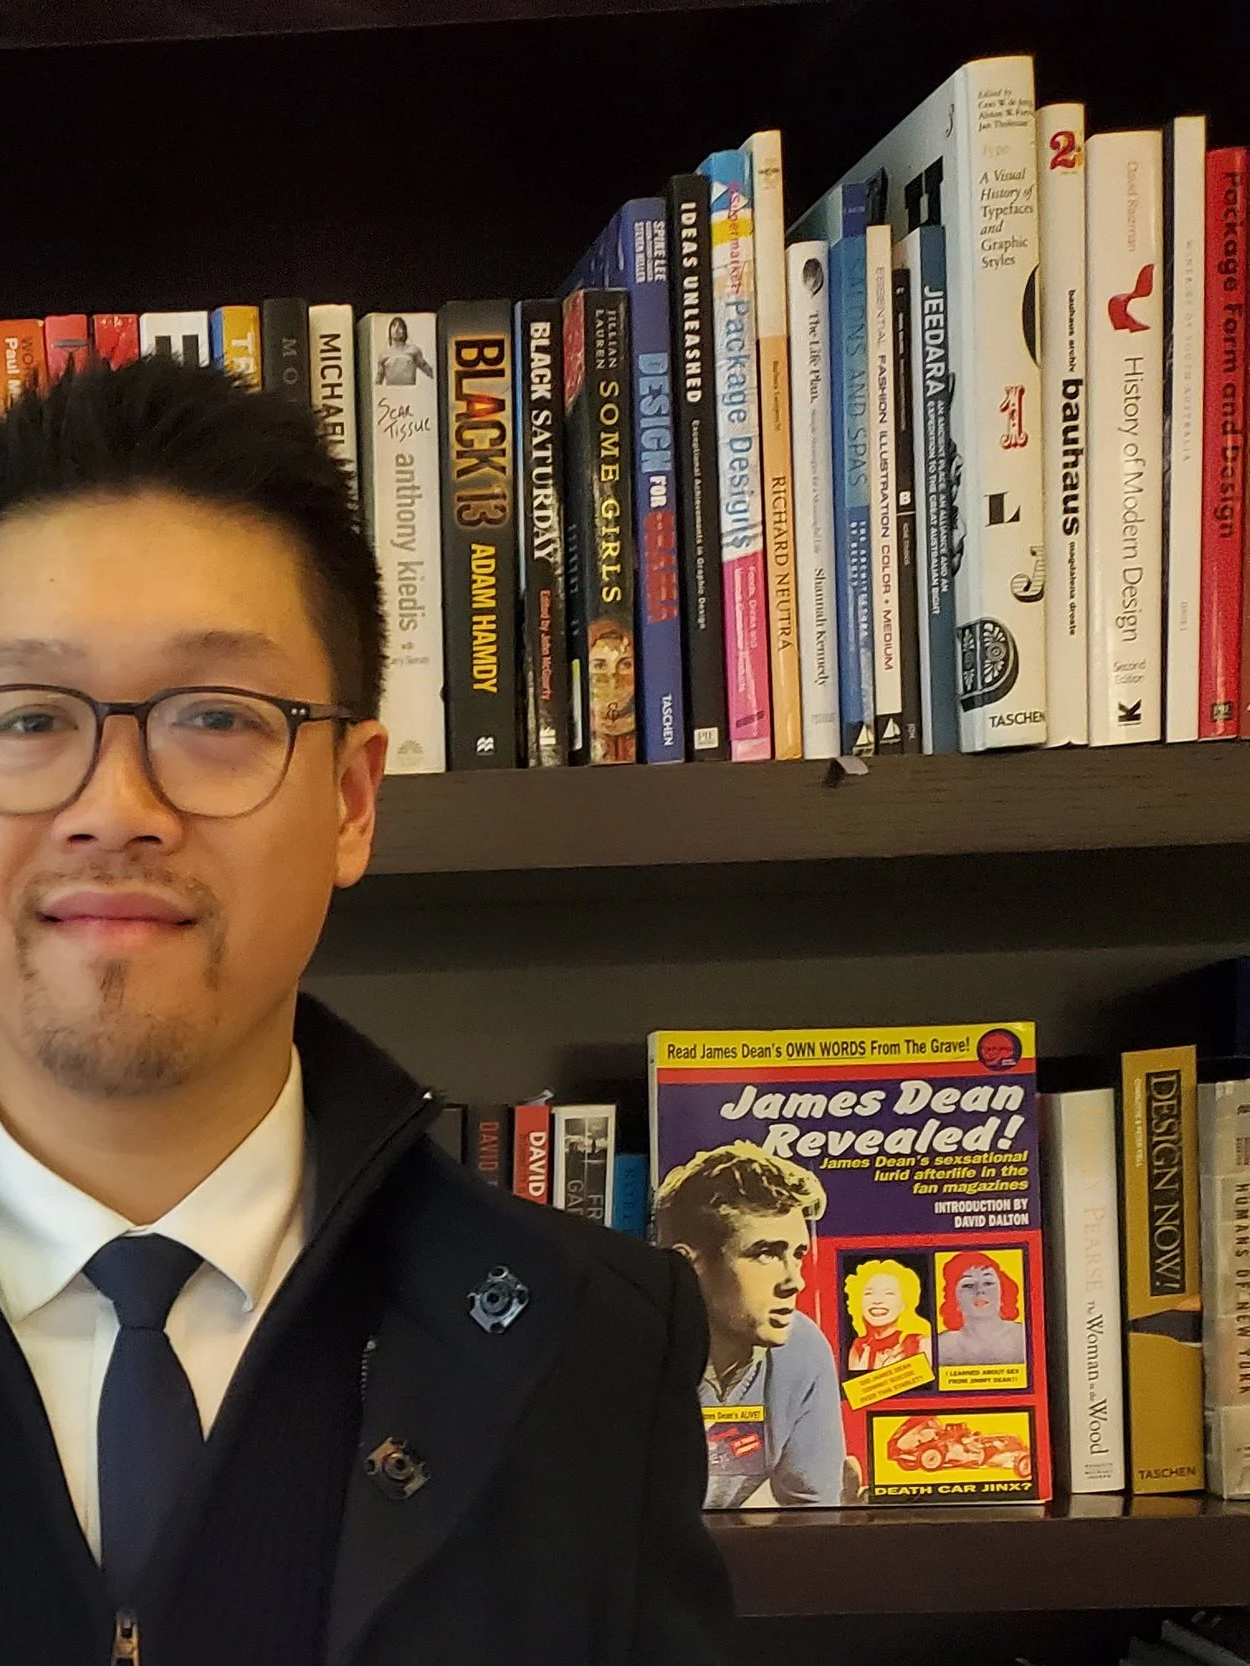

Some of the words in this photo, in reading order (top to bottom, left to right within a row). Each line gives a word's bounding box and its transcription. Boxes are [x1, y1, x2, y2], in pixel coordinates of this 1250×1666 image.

[681, 202, 697, 273] IDEAS
[529, 322, 553, 405] BLACK
[683, 276, 701, 403] UNLEASHED
[922, 285, 945, 396] JEEDARA
[456, 338, 507, 478] BLACK
[599, 380, 621, 483] SOME
[638, 352, 672, 475] DESIGN
[1118, 357, 1144, 433] History
[530, 410, 556, 565] SATURDAY
[649, 475, 667, 508] FOR
[1061, 378, 1084, 537] bauhaus
[1123, 443, 1145, 467] of
[393, 452, 426, 553] anthony
[456, 484, 507, 530] 13
[772, 476, 789, 566] RICHARD
[1122, 470, 1146, 562] Modern
[470, 543, 496, 611] ADAM
[601, 499, 622, 603] GIRLS
[397, 561, 425, 634] kiedis
[775, 573, 794, 651] NEUTRA
[1116, 565, 1144, 642] Design
[471, 613, 498, 695] HAMDY
[662, 693, 674, 746] TASCHEN
[667, 1044, 697, 1059] Read
[700, 1043, 738, 1059] James
[741, 1042, 783, 1057] Dean's
[786, 1042, 817, 1057] OWN
[819, 1041, 866, 1056] WORDS
[870, 1041, 901, 1055] From
[905, 1039, 927, 1054] The
[931, 1037, 970, 1054] Grave!
[720, 1085, 886, 1120] James
[893, 1080, 1025, 1114] Dean
[762, 1115, 1025, 1159] Revealed!
[1150, 1075, 1183, 1191] DESIGN
[528, 1131, 545, 1198] DAVID
[934, 1199, 1011, 1214] INTRODUCTION
[1013, 1198, 1029, 1211] BY
[954, 1214, 986, 1228] DAVID
[988, 1213, 1029, 1227] DALTON
[1153, 1202, 1182, 1289] NOW!
[875, 1486, 933, 1496] DEATH
[937, 1484, 976, 1494] CAR
[981, 1482, 1033, 1493] JINX?
